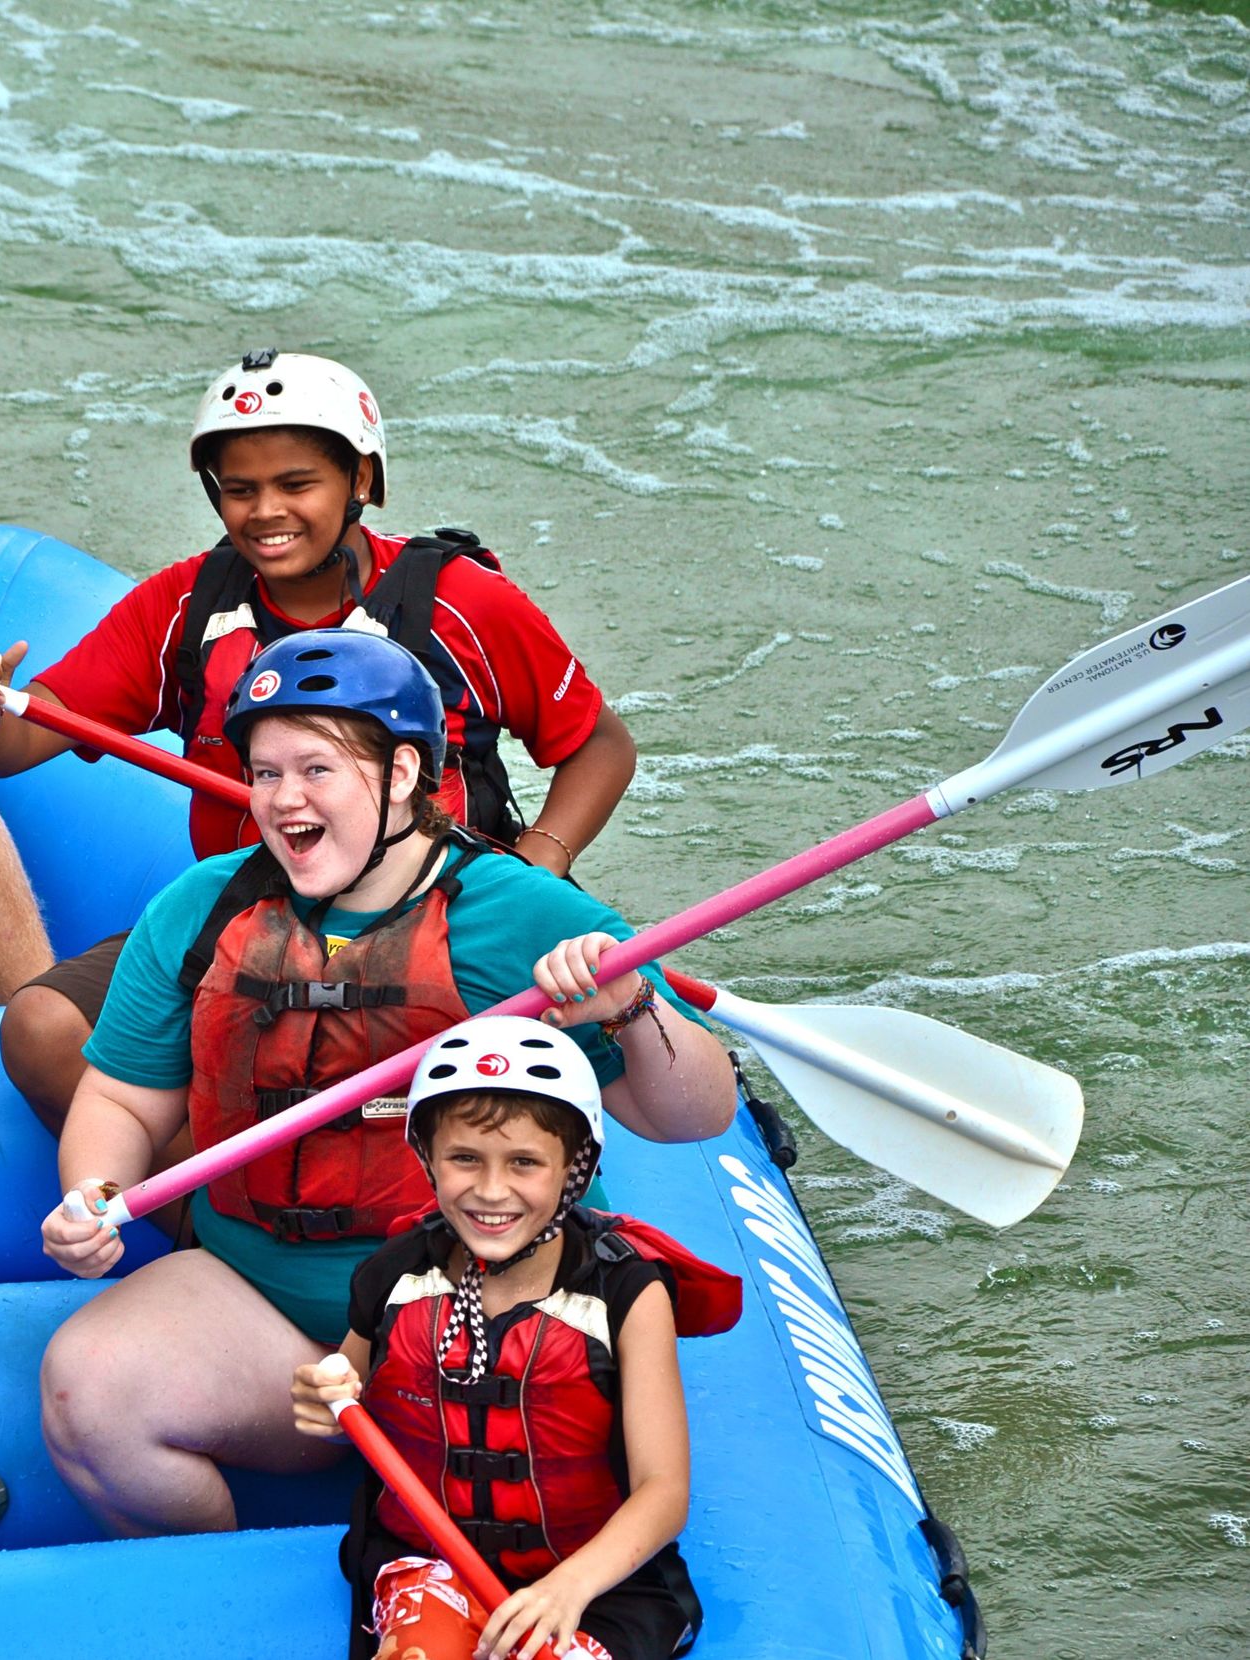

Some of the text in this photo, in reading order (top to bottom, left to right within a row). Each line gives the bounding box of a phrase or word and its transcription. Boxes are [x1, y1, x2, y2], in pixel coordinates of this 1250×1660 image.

[1047, 641, 1147, 694] WHITEWATER CENTER
[1086, 658, 1133, 683] NATIONAL
[198, 735, 223, 746] NRS
[1100, 706, 1224, 776] NRS
